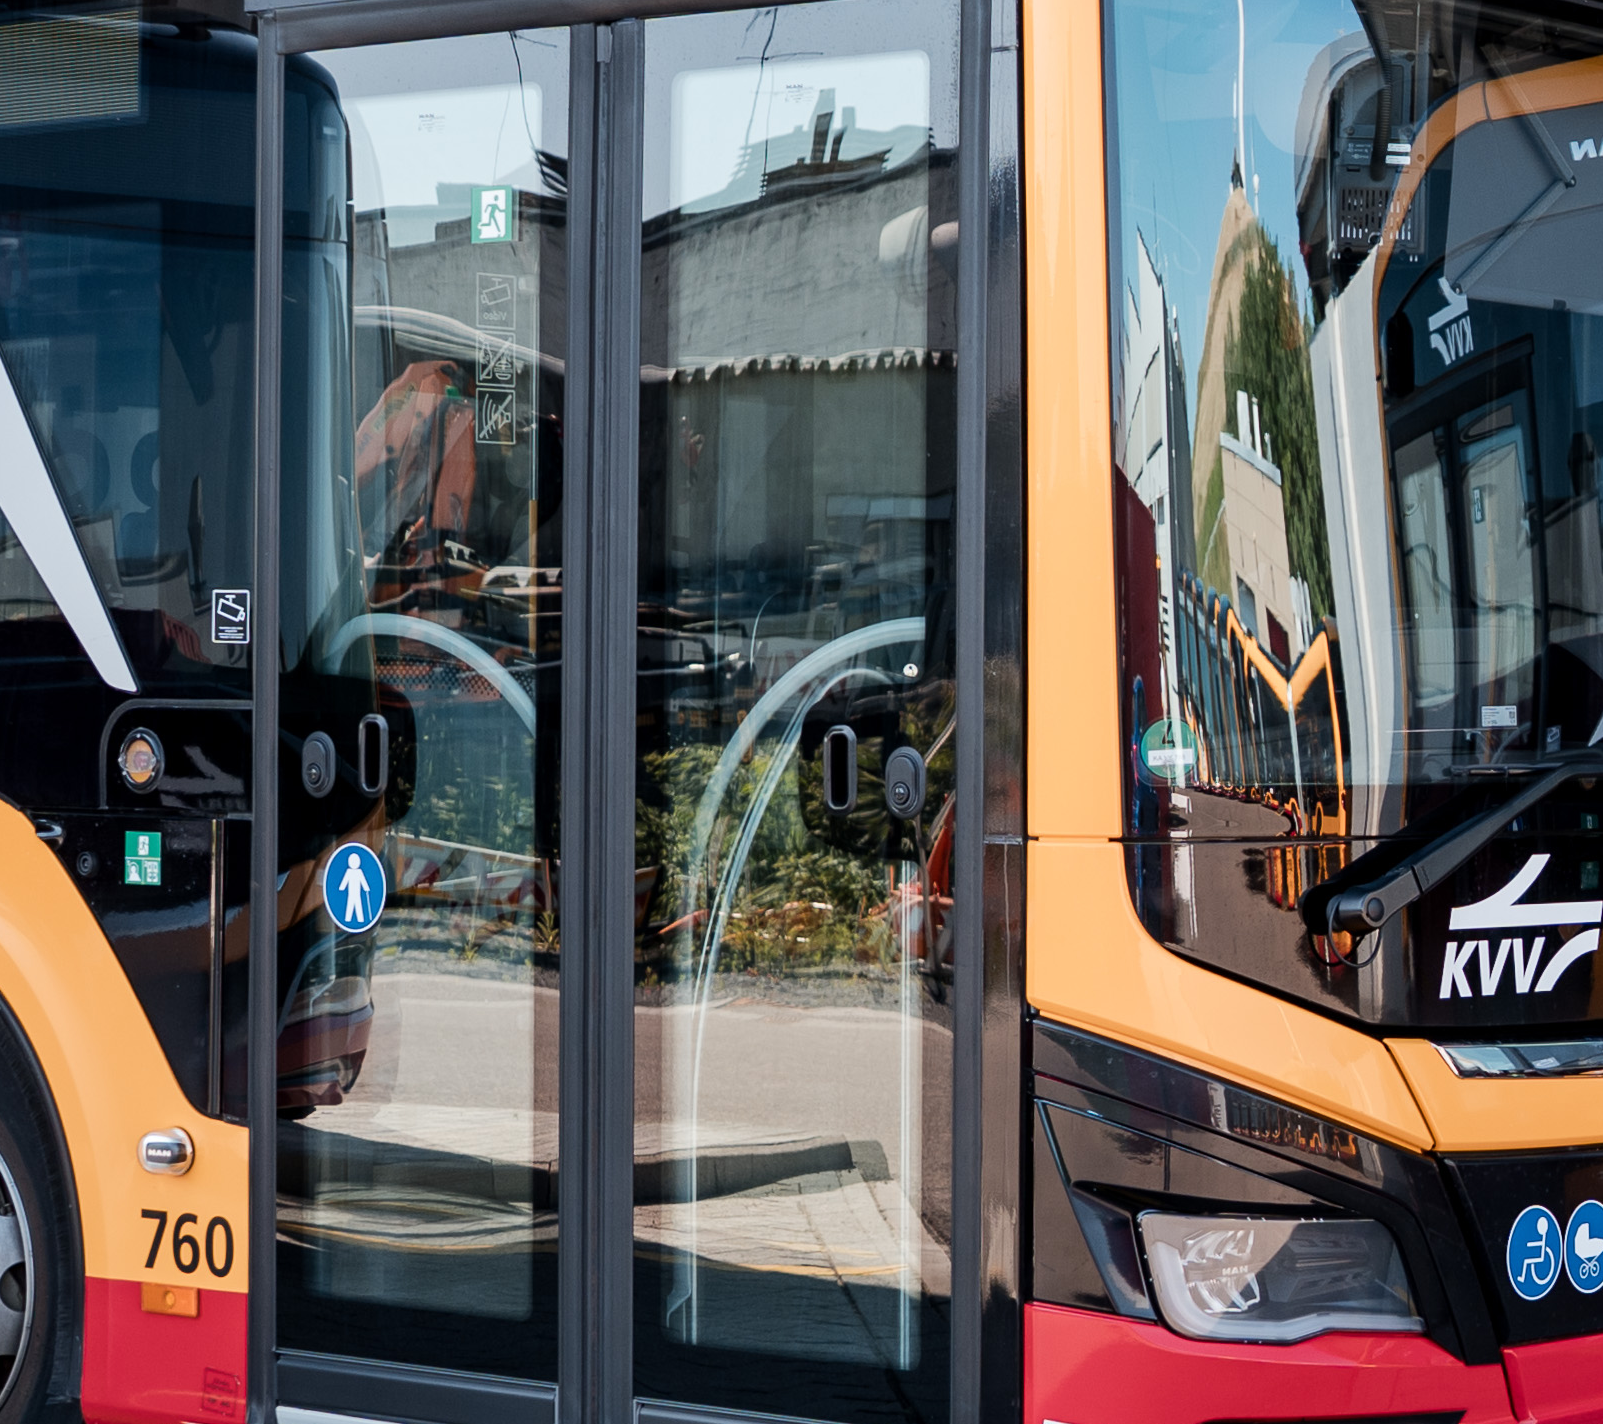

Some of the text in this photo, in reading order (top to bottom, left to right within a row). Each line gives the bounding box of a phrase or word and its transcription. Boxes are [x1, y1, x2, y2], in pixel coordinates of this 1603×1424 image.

[1437, 936, 1545, 999] KVV
[148, 1148, 171, 1157] MAN
[141, 1208, 234, 1278] 760
